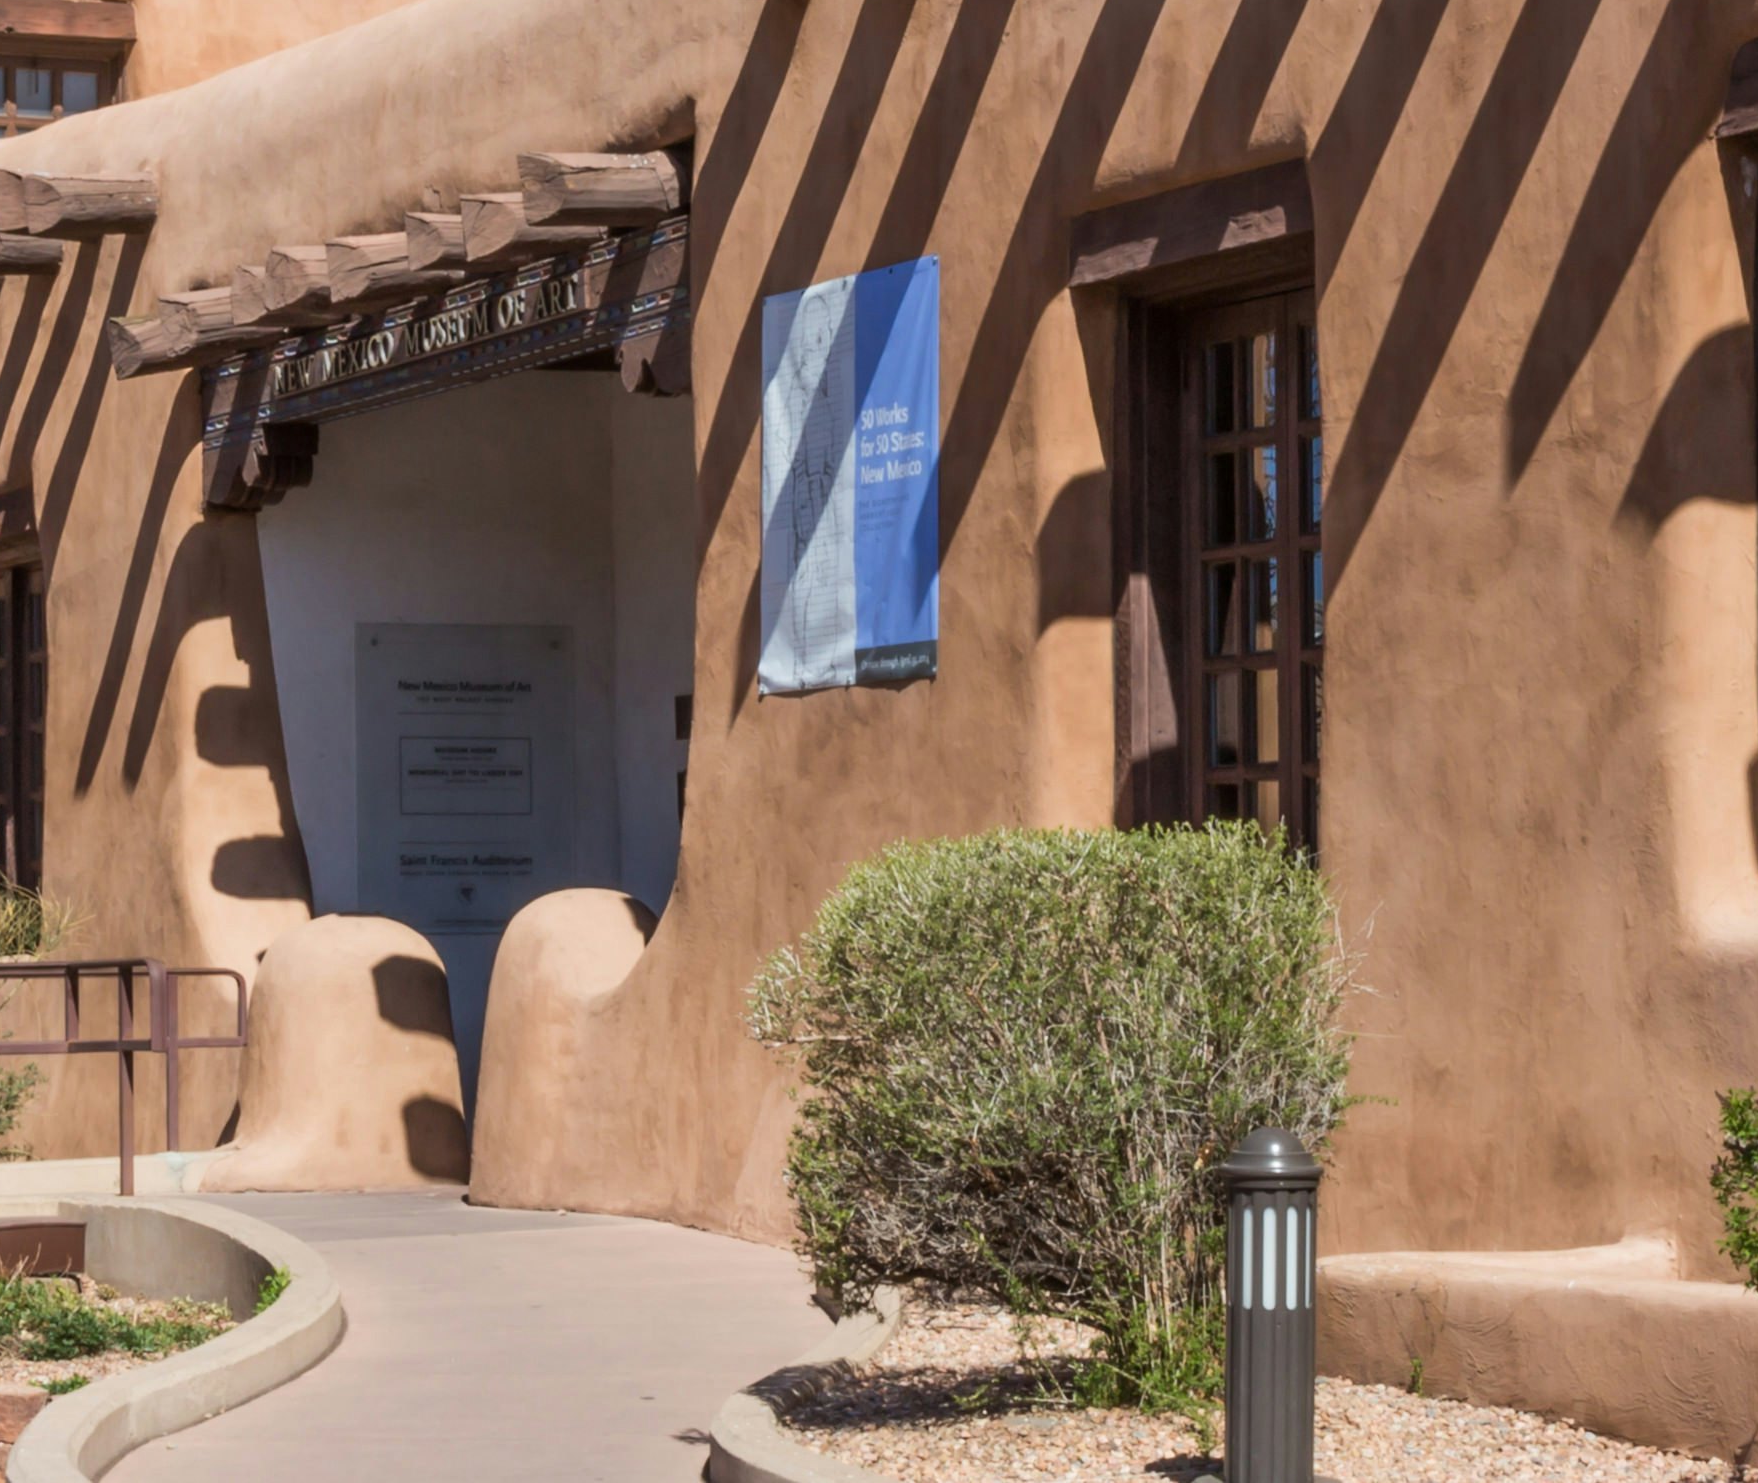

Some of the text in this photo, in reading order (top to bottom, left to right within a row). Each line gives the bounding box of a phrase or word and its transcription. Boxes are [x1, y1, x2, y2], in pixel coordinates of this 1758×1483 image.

[273, 272, 579, 397] NEW MEXICO MUSEUM OF ART
[860, 401, 909, 431] 50 Works
[860, 435, 874, 457] for
[875, 433, 889, 455] 50
[861, 457, 922, 484] New Mexico
[397, 680, 420, 691] New
[422, 680, 458, 691] Mexico
[459, 680, 504, 692] Museum
[516, 681, 532, 692] Art
[400, 854, 533, 866] Saint Francis Auditorium
